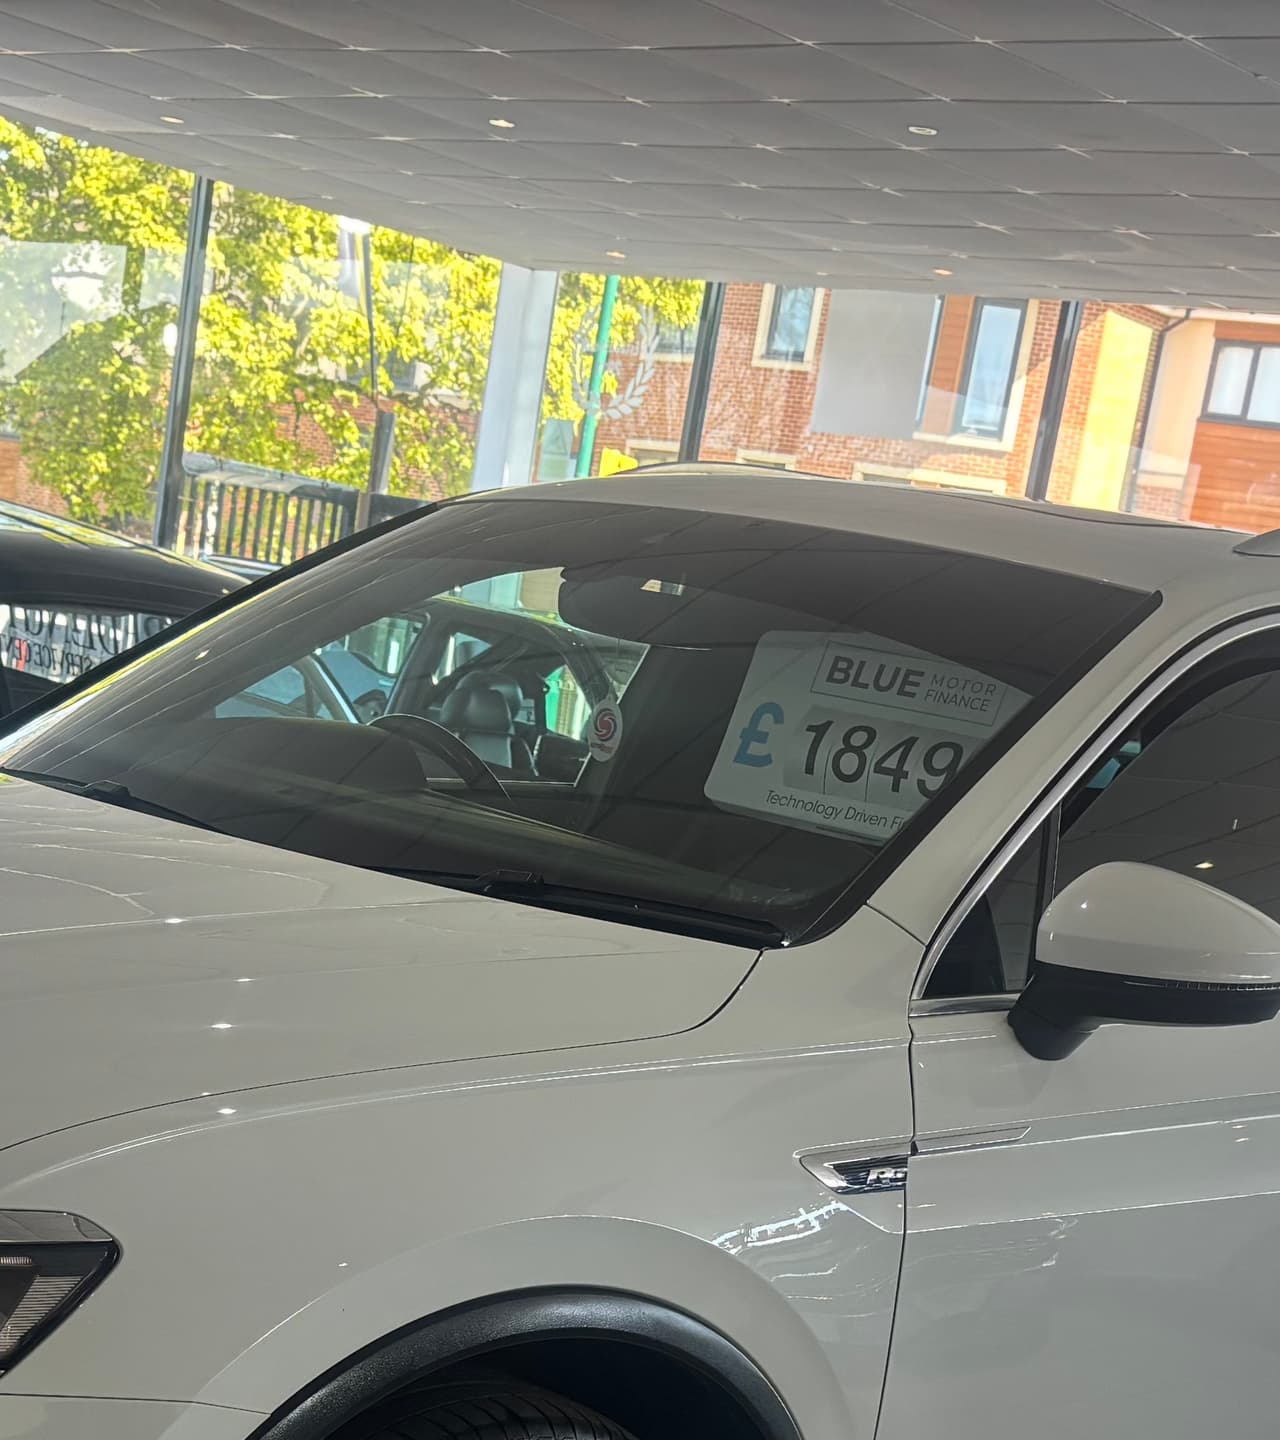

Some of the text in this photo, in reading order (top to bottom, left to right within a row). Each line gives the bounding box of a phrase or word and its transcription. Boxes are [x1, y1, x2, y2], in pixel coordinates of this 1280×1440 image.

[825, 656, 926, 699] BLUE
[930, 673, 997, 696] MOTOR
[925, 688, 992, 713] FINANCE
[766, 790, 844, 820] Technology
[844, 806, 888, 828] Driven
